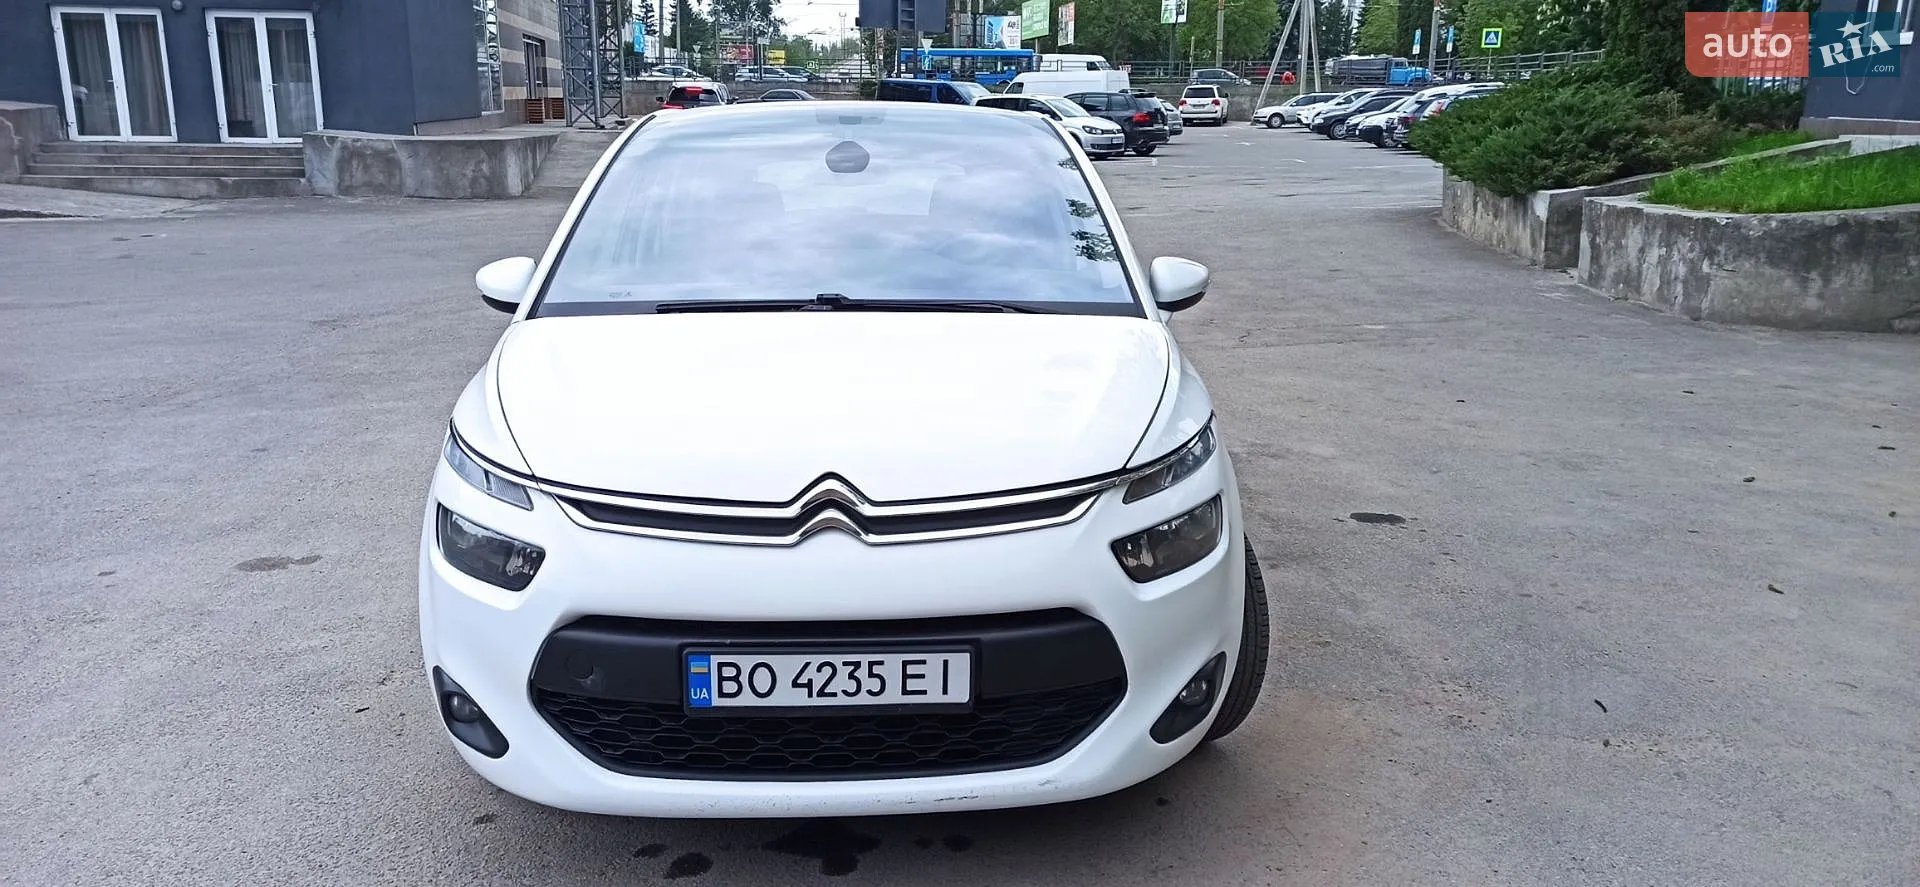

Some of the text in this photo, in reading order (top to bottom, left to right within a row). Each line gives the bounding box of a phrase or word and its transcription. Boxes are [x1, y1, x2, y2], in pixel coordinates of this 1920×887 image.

[716, 661, 778, 699] BO
[791, 659, 887, 698] 4235
[690, 687, 709, 700] UA
